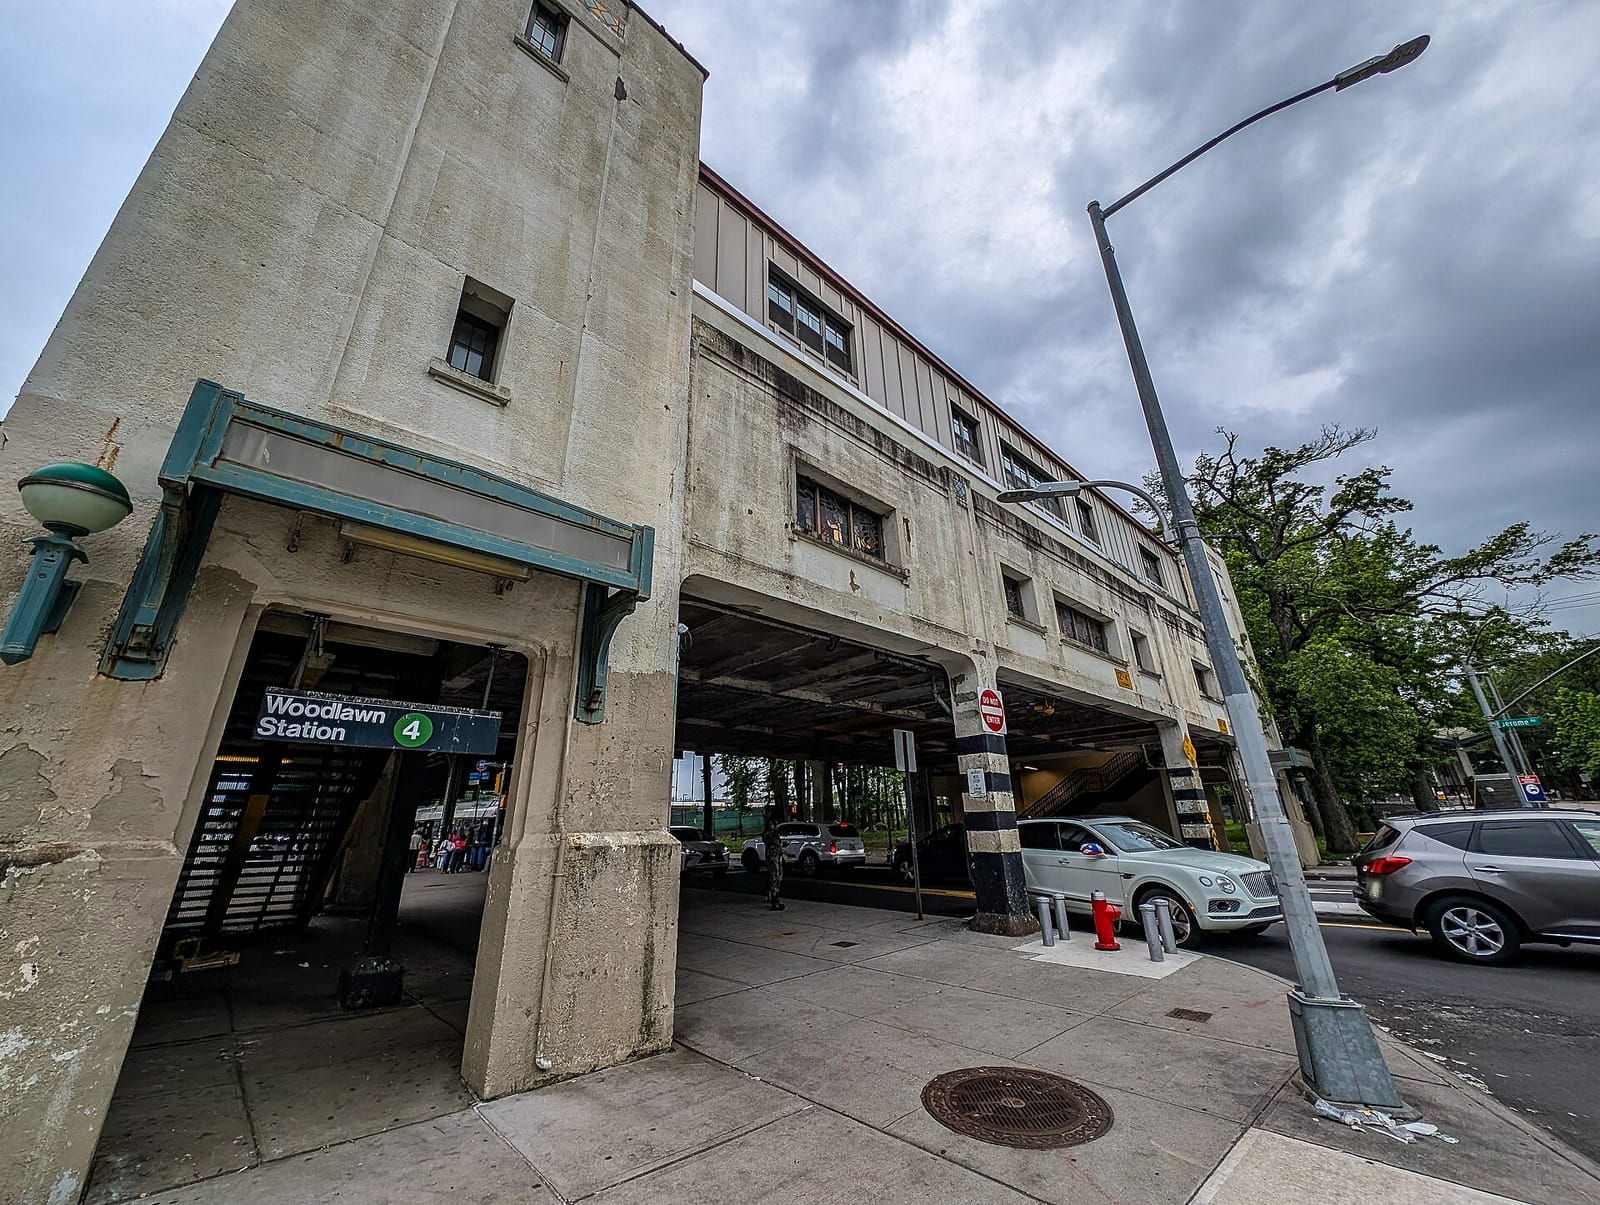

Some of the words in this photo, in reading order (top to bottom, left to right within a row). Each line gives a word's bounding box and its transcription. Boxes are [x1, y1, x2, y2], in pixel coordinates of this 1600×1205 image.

[982, 696, 989, 704] DO
[990, 697, 999, 706] NOT
[266, 696, 386, 724] Woodlawn
[402, 720, 422, 740] 4
[986, 716, 1000, 724] ENTER
[257, 717, 346, 741] Station
